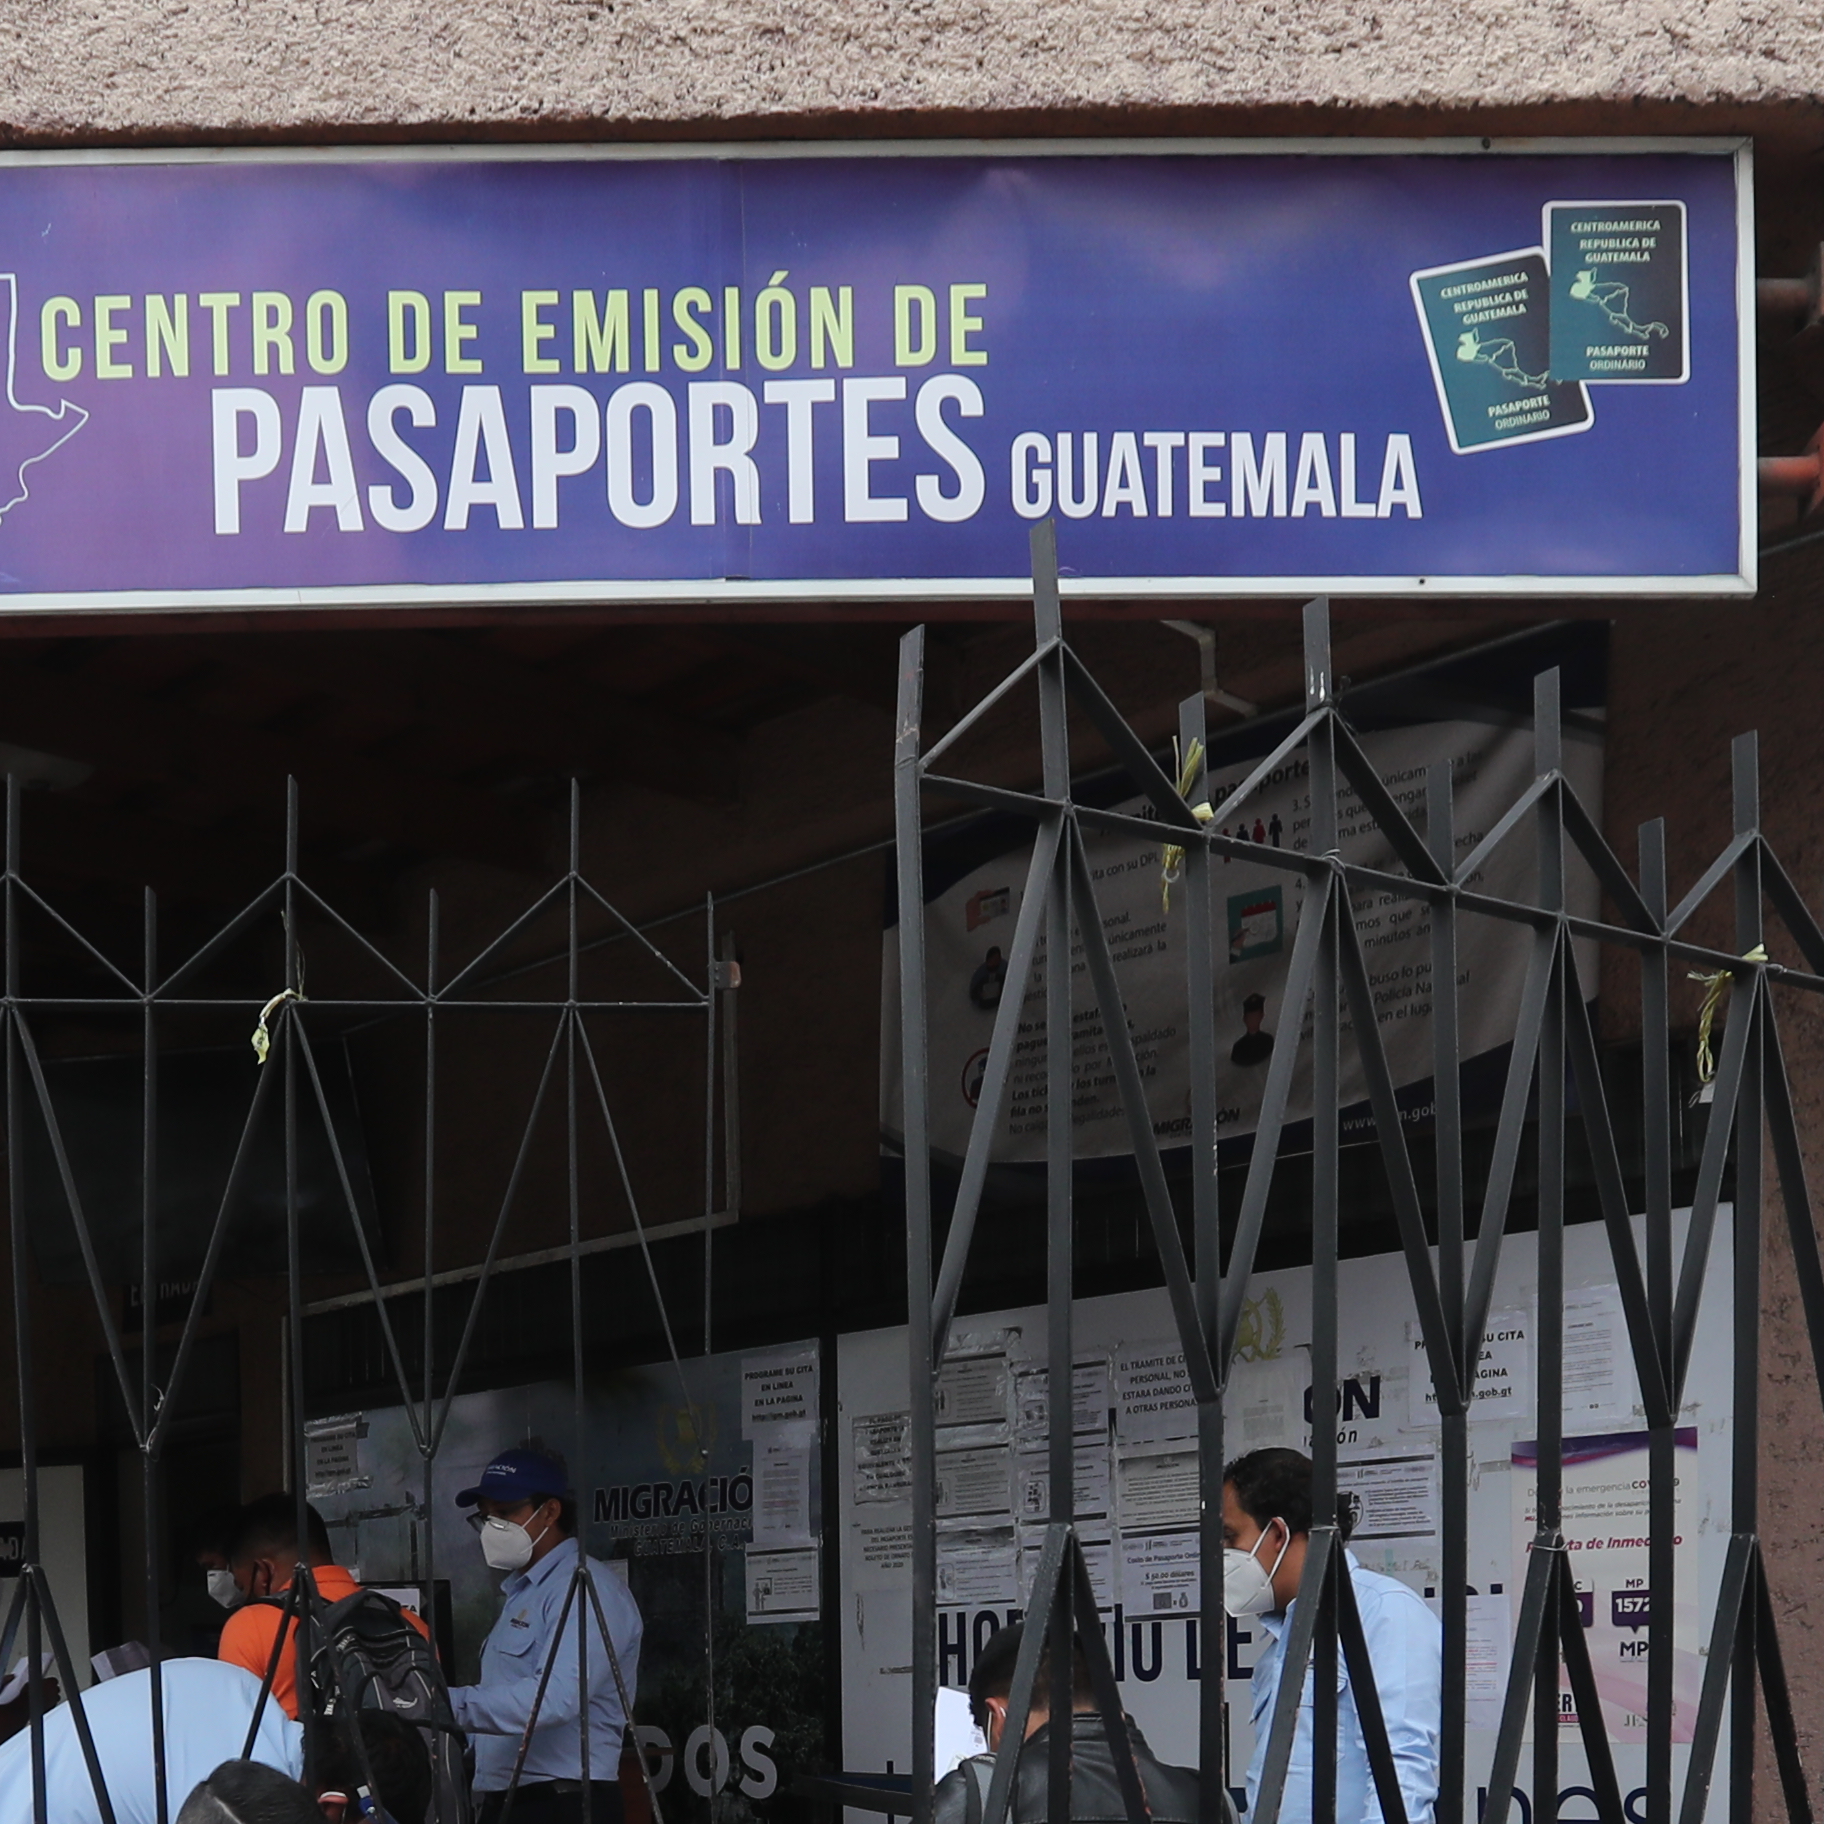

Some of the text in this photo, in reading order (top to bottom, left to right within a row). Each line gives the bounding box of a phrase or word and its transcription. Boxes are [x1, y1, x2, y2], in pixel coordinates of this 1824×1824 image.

[1570, 220, 1660, 233] CENTROAMERICA
[1579, 237, 1656, 250] REPUBLICA DE
[1585, 251, 1650, 263] GUATEMALA
[1440, 272, 1528, 299] CENTROAMERICA
[1453, 288, 1528, 314] REPUBLICA DE
[1462, 303, 1527, 325] GUATEMALA
[41, 271, 987, 381] CENTRO DE EMISIÓN DE
[1586, 345, 1650, 358] PASAPORTE
[1487, 394, 1551, 418] PASAPORTE
[211, 374, 984, 534] PASAPORTES
[1011, 432, 1422, 519] GUATEMALA
[1107, 860, 1138, 877] con su
[1389, 910, 1412, 925] que
[1364, 929, 1412, 949] minutos
[1401, 967, 1413, 979] lo
[1374, 984, 1412, 1006] Policía
[1379, 1005, 1408, 1023] en el
[1017, 1021, 1034, 1035] No
[1084, 1061, 1102, 1076] por
[1012, 1066, 1156, 1101] Los los la
[1010, 1103, 1043, 1118] fila no
[1009, 1121, 1022, 1135] No
[1497, 1330, 1525, 1342] CITA
[796, 1365, 813, 1374] CITA
[1120, 1356, 1176, 1371] EL TRAMITE DE
[1173, 1369, 1186, 1378] NO
[761, 1383, 771, 1391] EN
[1122, 1384, 1182, 1400] ESTARA DANDO
[754, 1398, 764, 1407] EN
[766, 1397, 775, 1405] LA
[1125, 1402, 1158, 1415] A OTRAS
[593, 1465, 754, 1524] MIGRACIÓ
[1566, 1482, 1631, 1495] la emergencia
[609, 1520, 685, 1541] Ministerio de
[717, 1532, 745, 1552] C.A.
[1586, 1537, 1604, 1550] de
[1626, 1579, 1644, 1589] MP
[1619, 1641, 1649, 1657] MP
